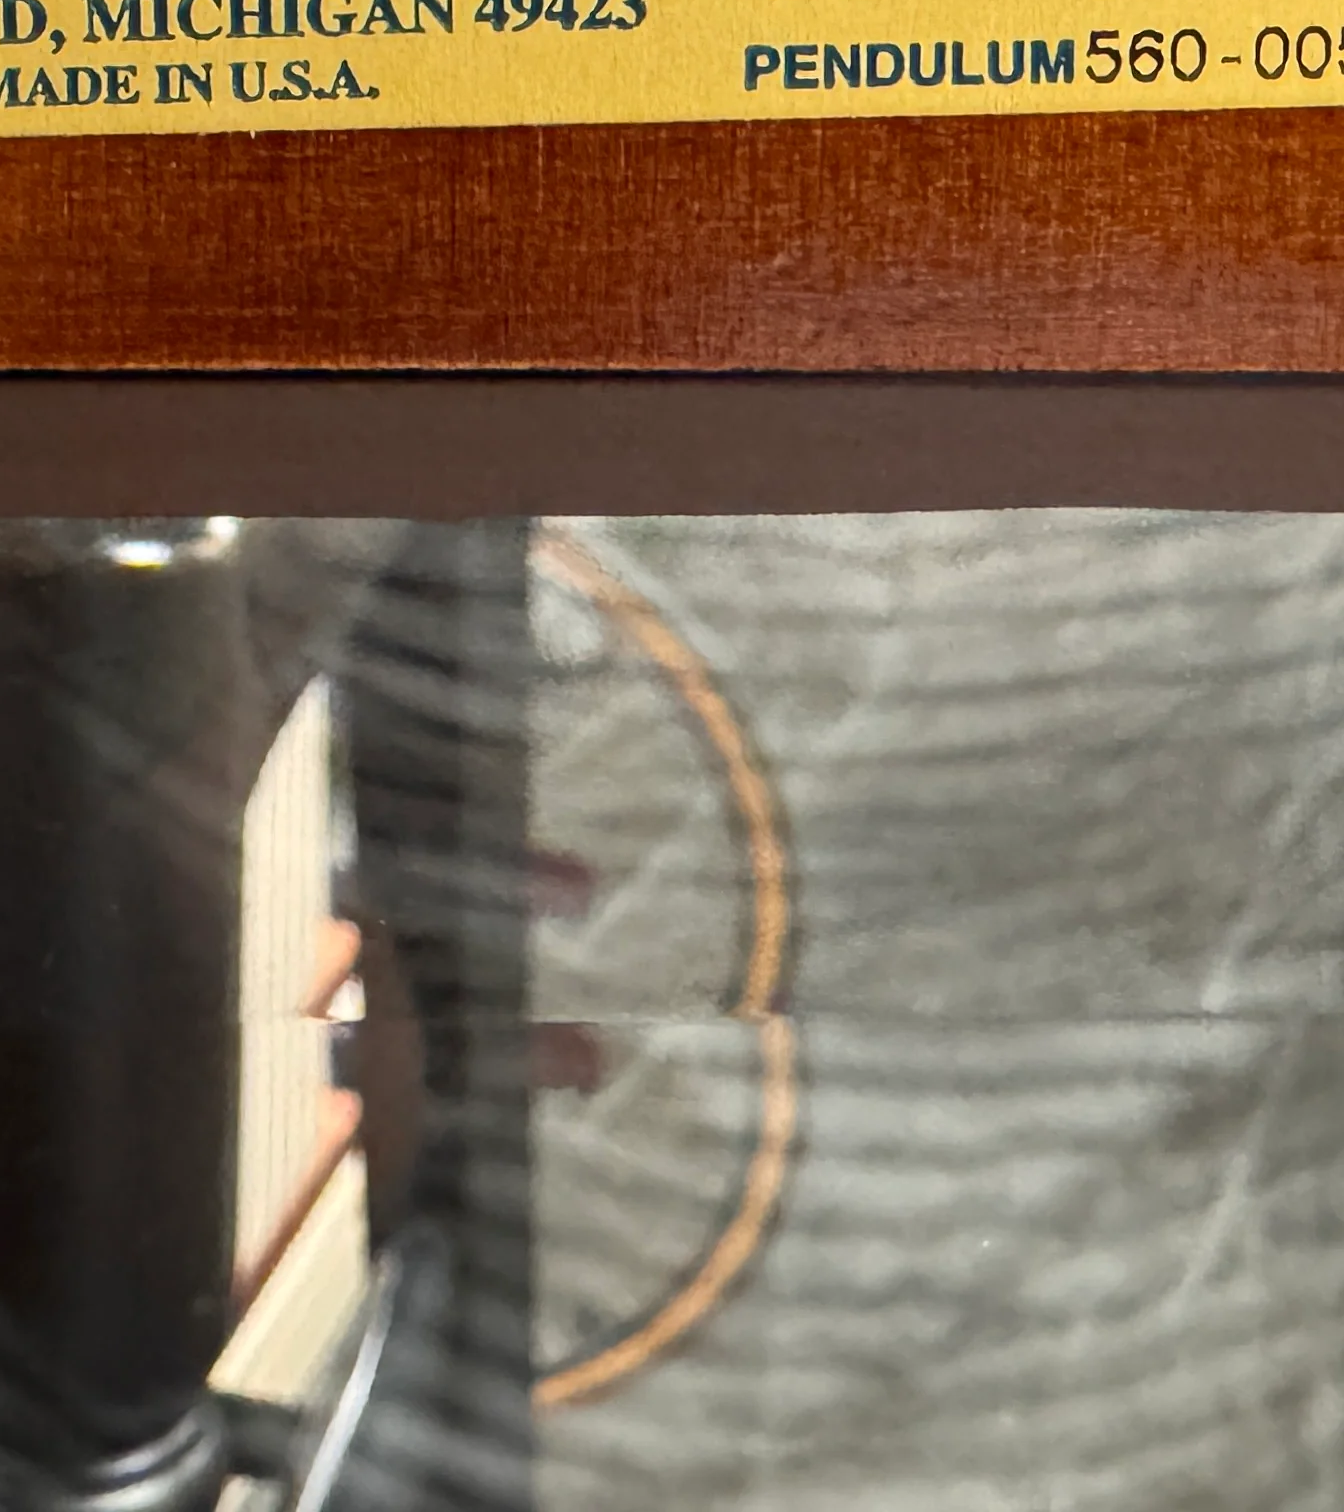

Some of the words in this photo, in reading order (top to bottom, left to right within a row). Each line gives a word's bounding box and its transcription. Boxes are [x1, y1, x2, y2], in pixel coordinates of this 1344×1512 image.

[154, 62, 213, 104] IN
[229, 59, 380, 103] U.S.A.
[744, 39, 1075, 91] PENDULUM
